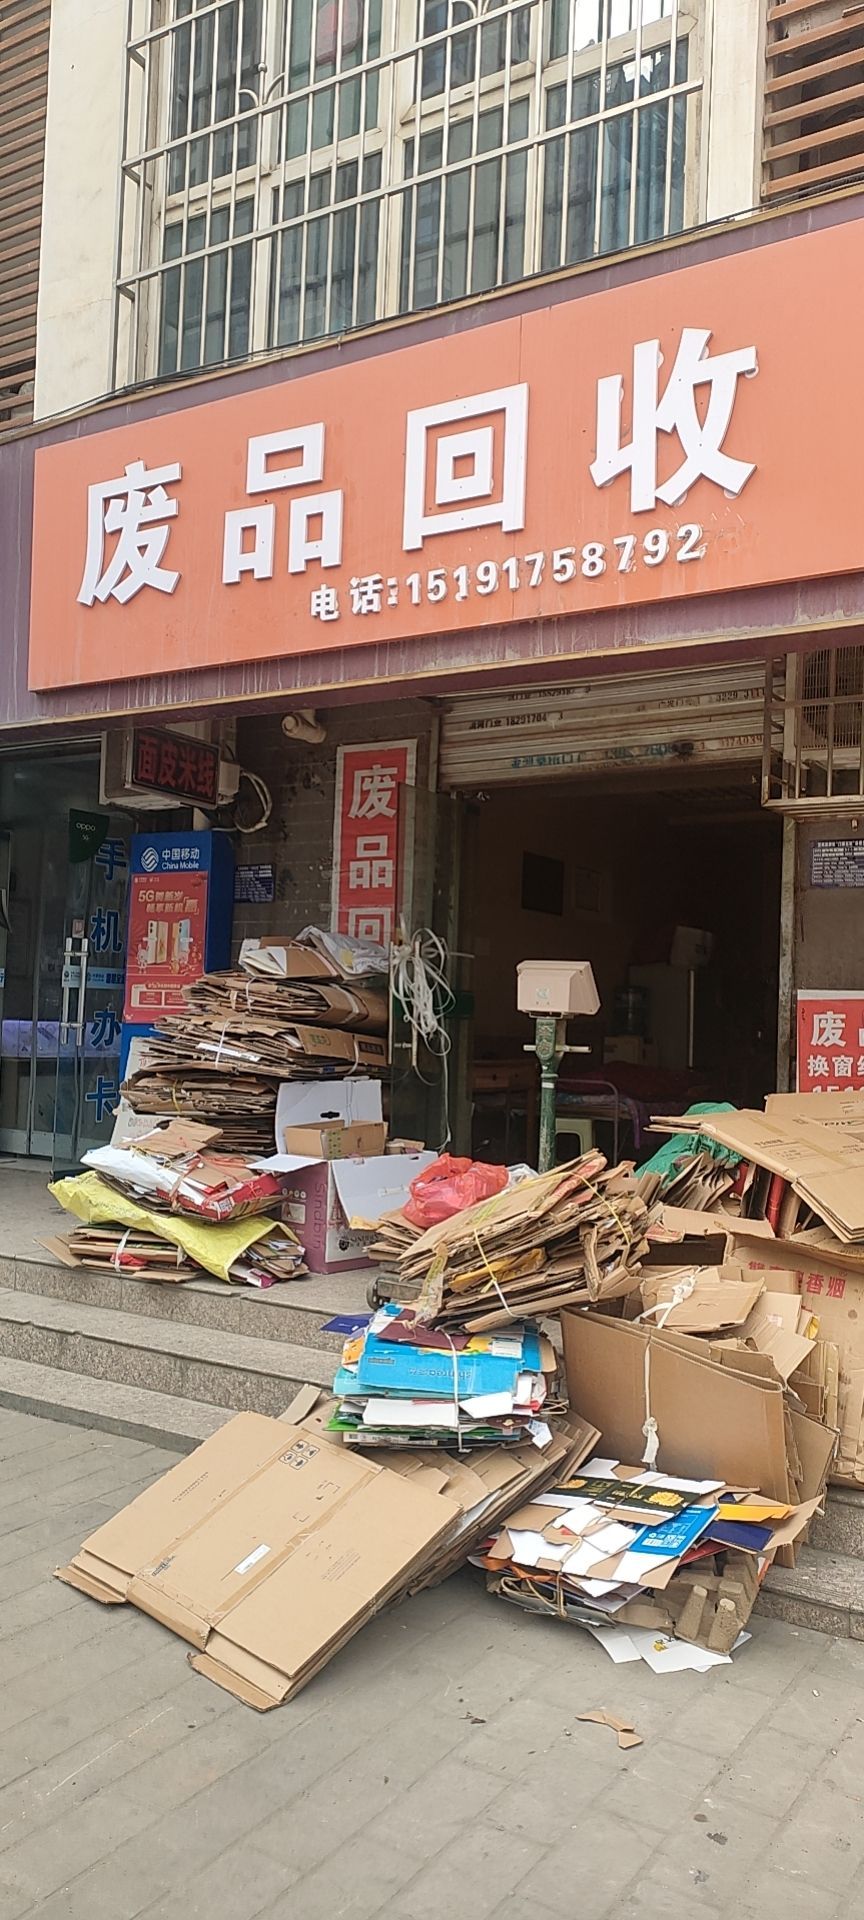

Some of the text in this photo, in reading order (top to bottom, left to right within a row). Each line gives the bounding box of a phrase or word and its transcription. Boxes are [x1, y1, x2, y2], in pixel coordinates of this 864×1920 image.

[77, 327, 757, 606] 废品回收
[138, 735, 214, 797] 面皮米线
[161, 847, 200, 861] 中国移动
[161, 860, 200, 870] China Mobile
[347, 764, 398, 948] 废品回
[810, 1010, 864, 1048] 废
